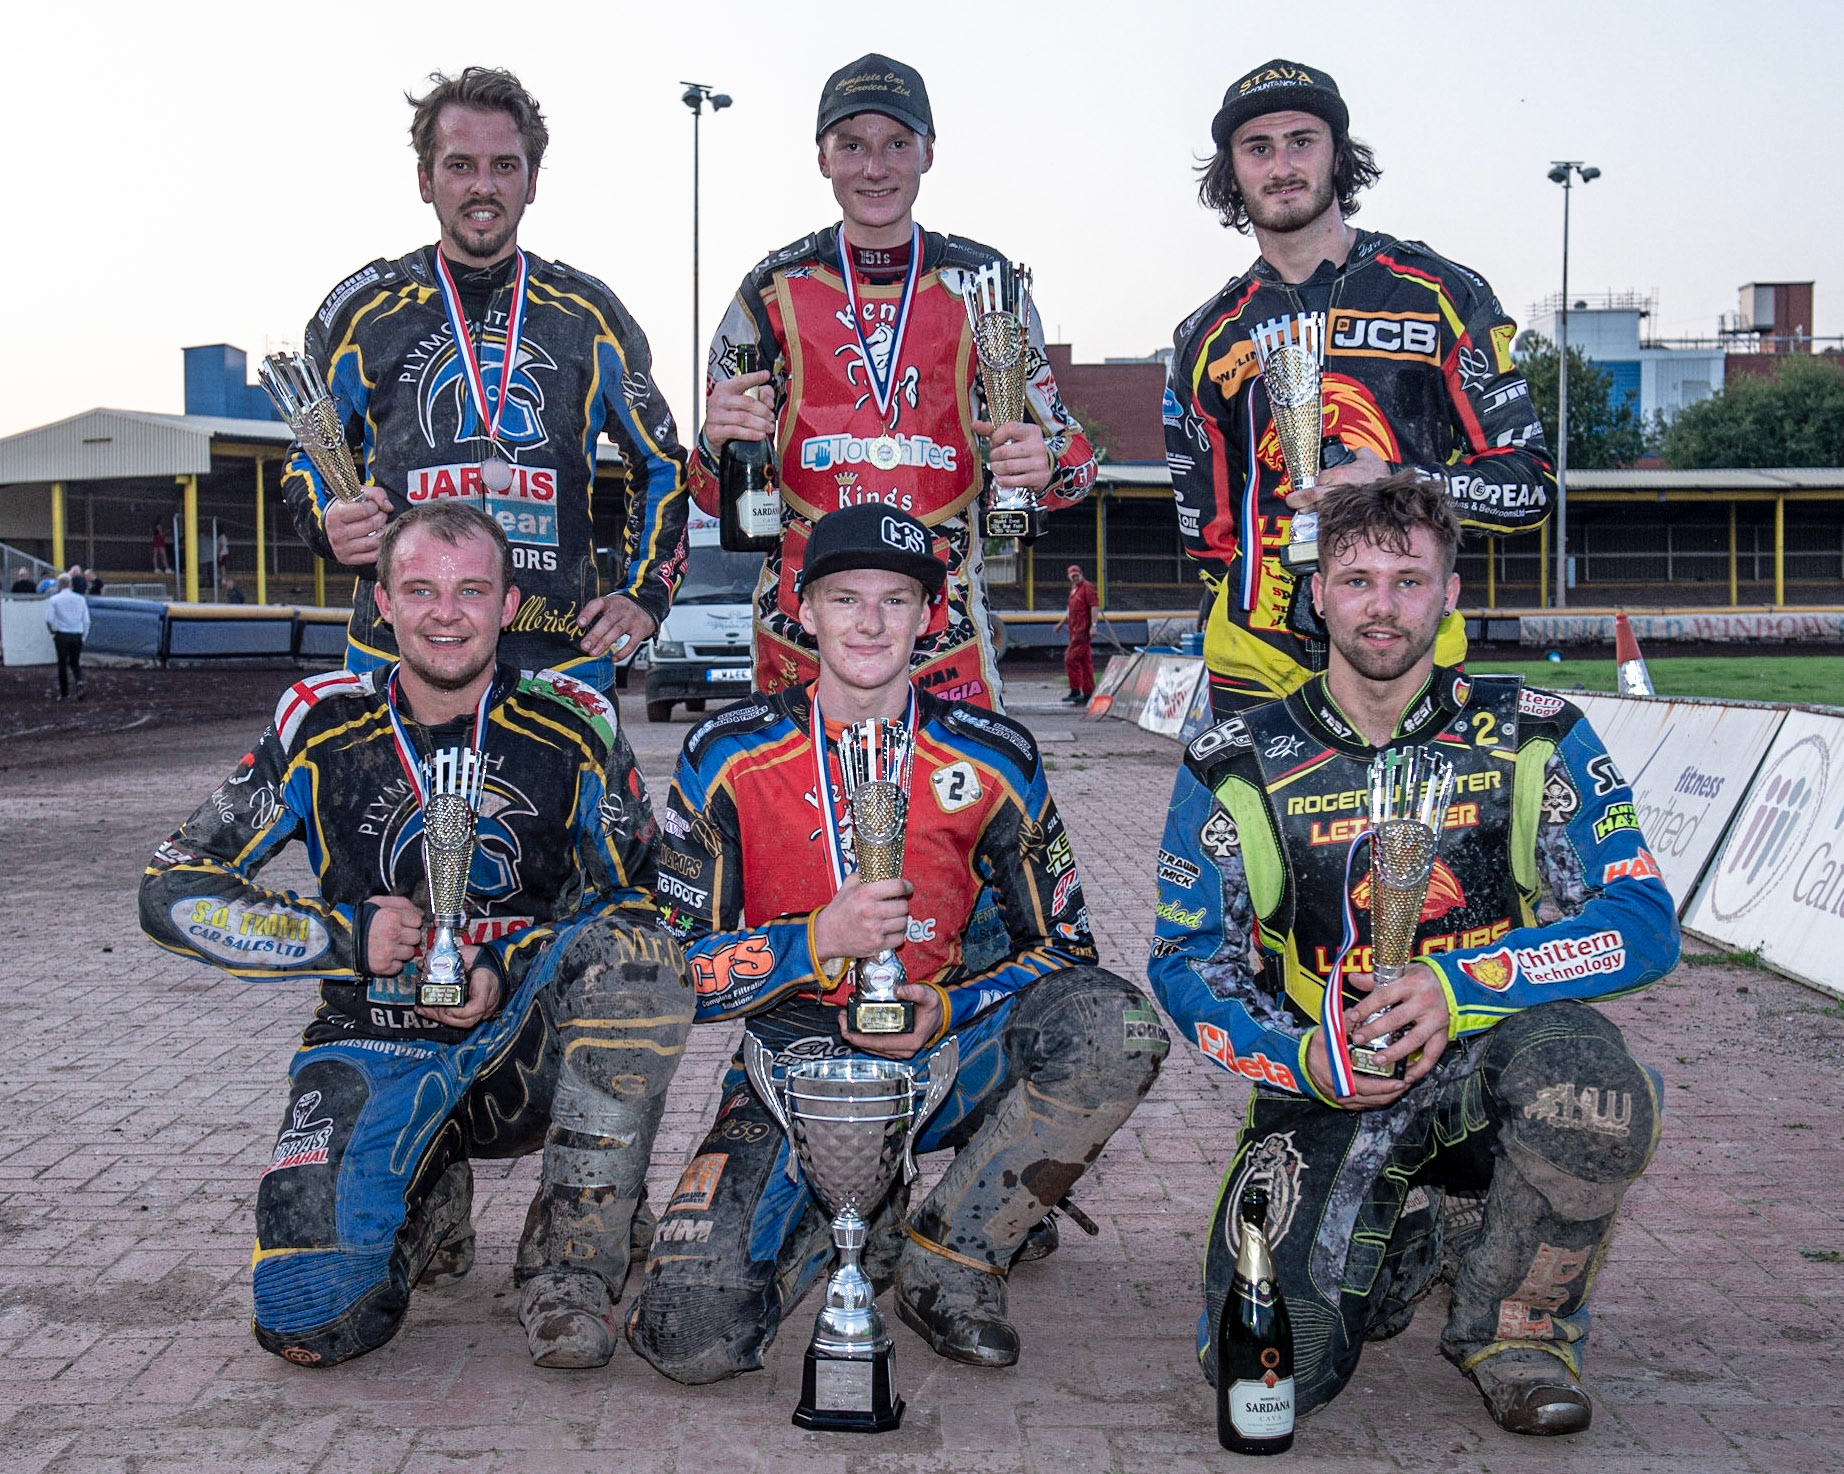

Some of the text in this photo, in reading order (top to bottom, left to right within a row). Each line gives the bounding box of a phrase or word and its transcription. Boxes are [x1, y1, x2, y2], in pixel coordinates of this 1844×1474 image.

[1239, 67, 1314, 93] STAVA
[958, 243, 999, 261] KICKSTA
[835, 302, 897, 331] Ken
[1334, 318, 1436, 355] JCB
[832, 434, 954, 468] TohTec
[752, 507, 780, 516] SARDA
[838, 485, 913, 512] Kings
[1181, 516, 1199, 529] OIL
[1520, 690, 1563, 708] ltern
[1472, 711, 1500, 745] 2
[949, 772, 966, 802] 2
[1591, 756, 1626, 794] SL
[1675, 764, 1726, 802] fitness
[358, 752, 504, 836] PLYMH
[1287, 788, 1369, 815] ROGER
[1311, 801, 1480, 846] LEIER
[1596, 814, 1640, 838] HAZ
[1161, 868, 1192, 887] MICK
[189, 925, 307, 958] CAR SALES LTD
[1516, 932, 1619, 969] Chiltern
[689, 933, 776, 996] CFS
[1523, 952, 1622, 983] Technology
[701, 978, 767, 1008] Complete Filtration
[370, 1007, 438, 1029] GLAD
[1225, 1040, 1299, 1092] Beta
[280, 1148, 327, 1167] MAHAL
[1245, 1400, 1291, 1413] SARDANA
